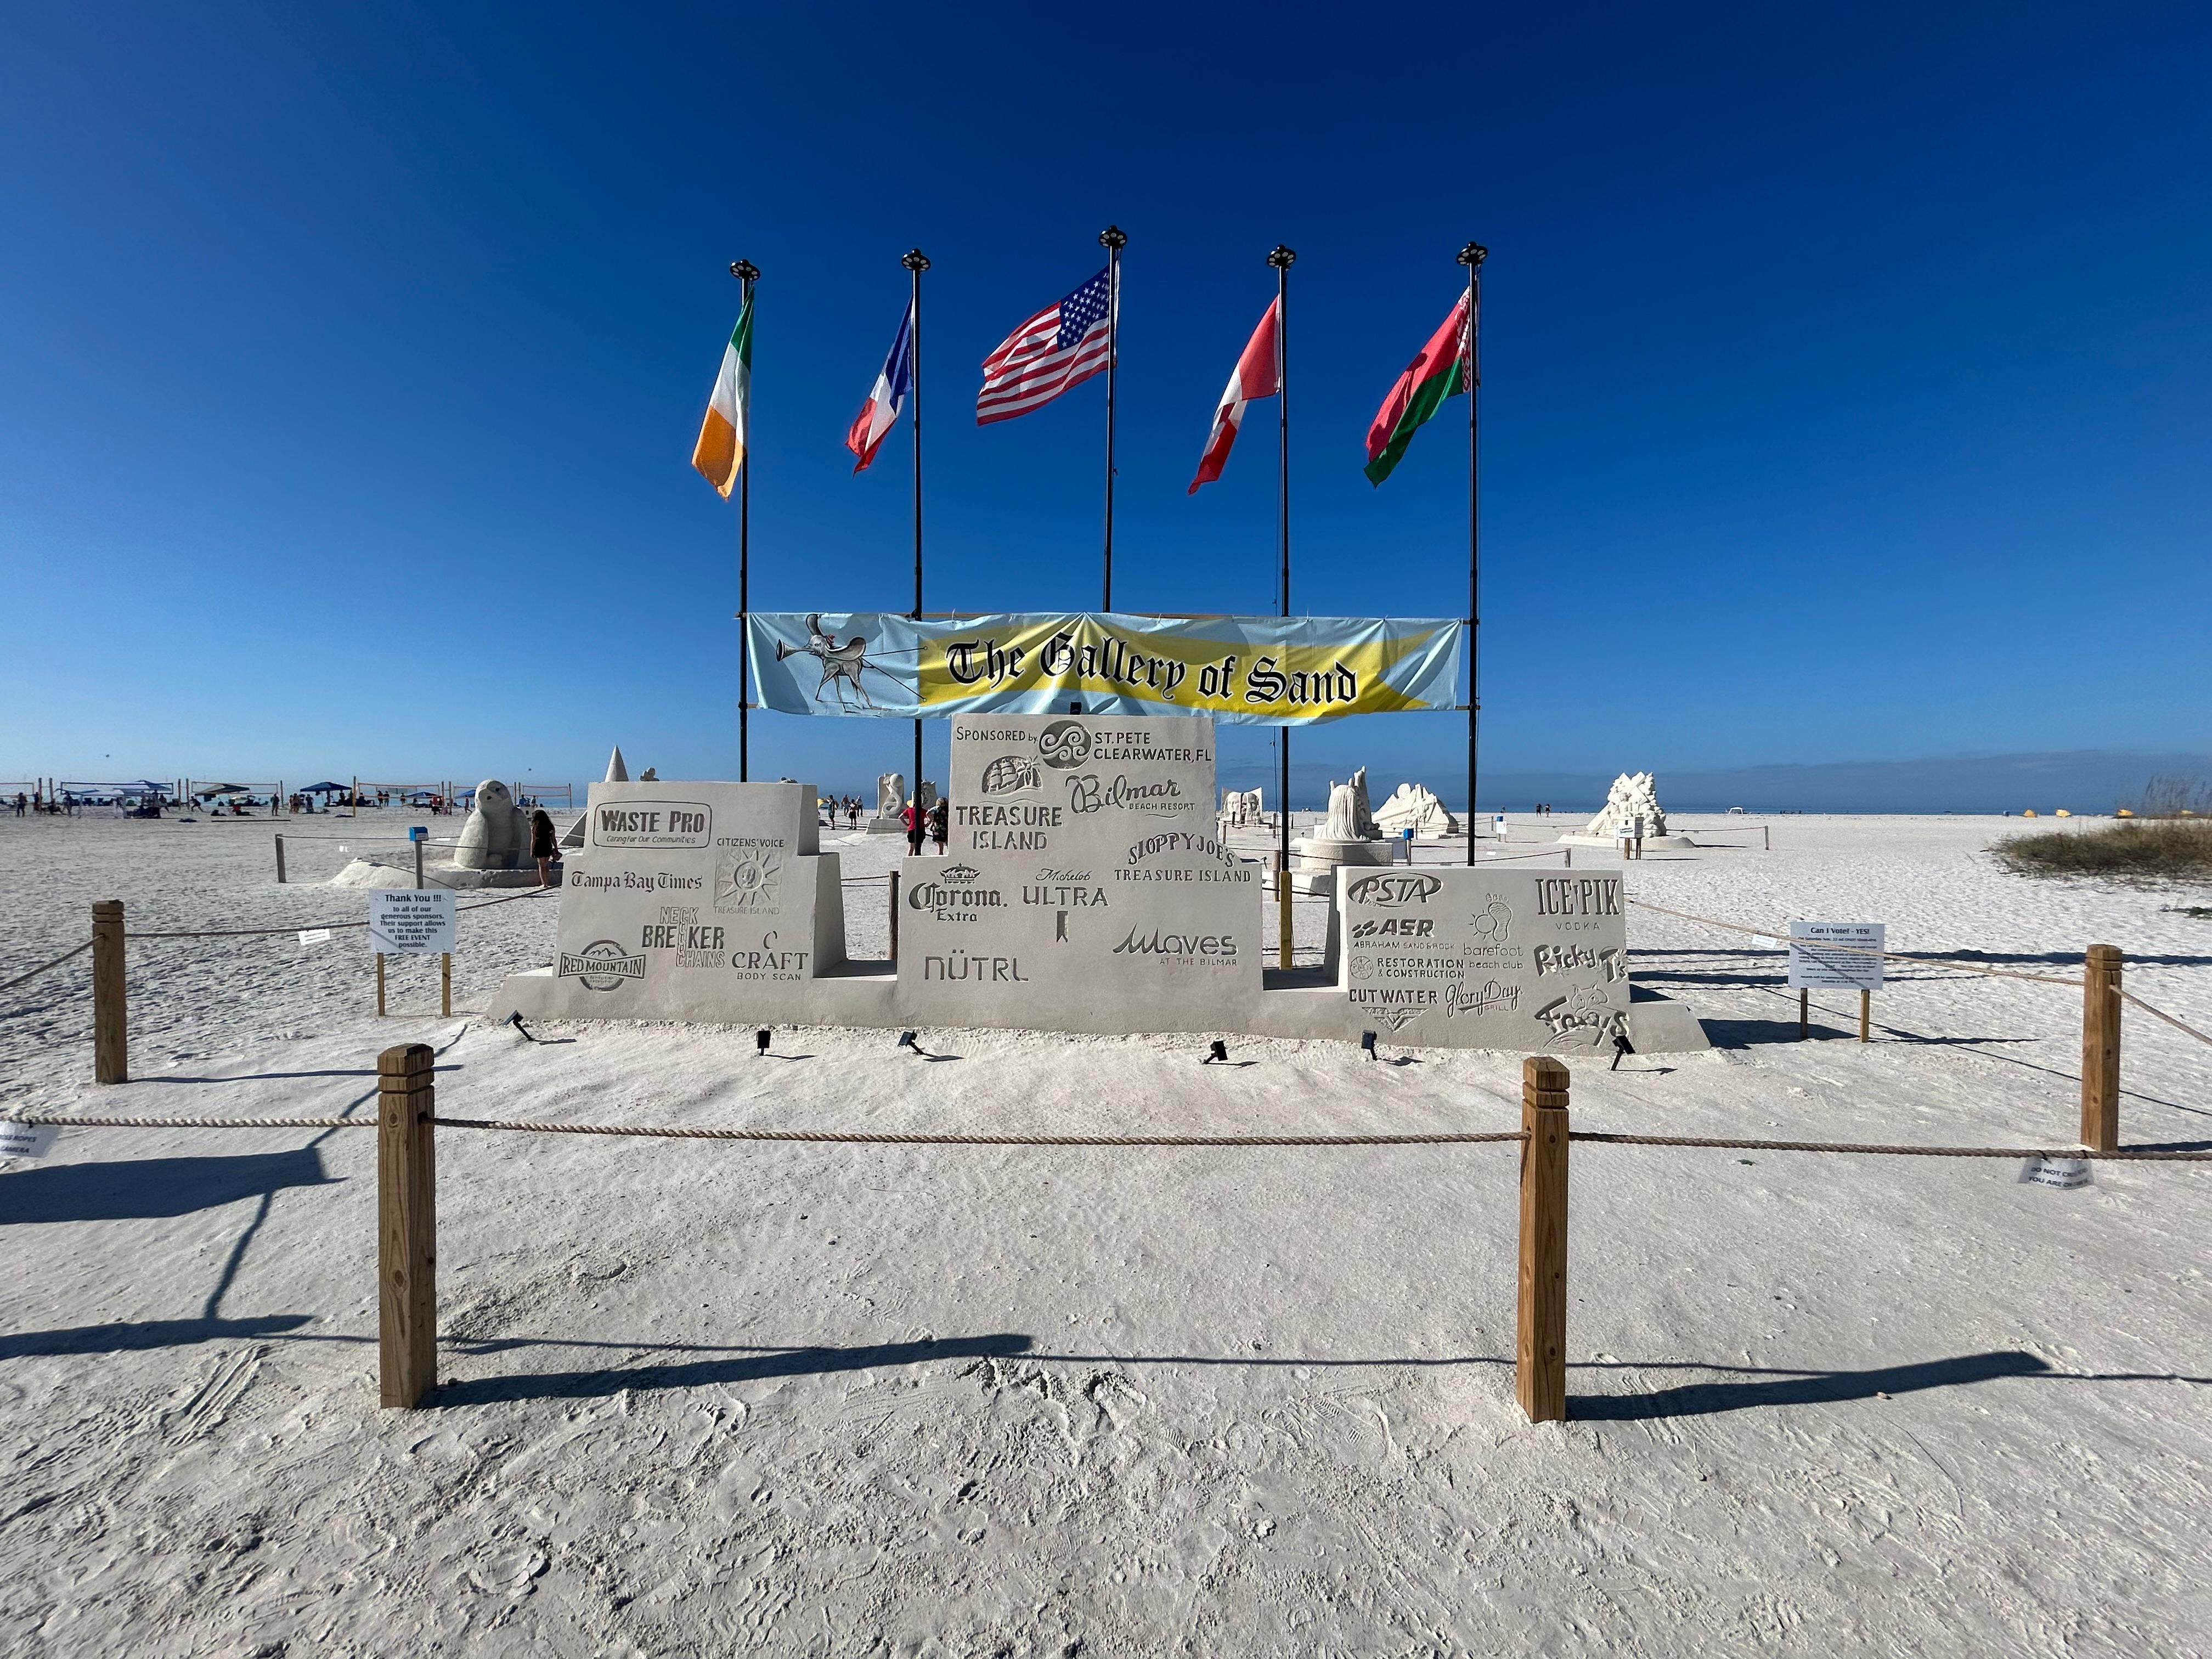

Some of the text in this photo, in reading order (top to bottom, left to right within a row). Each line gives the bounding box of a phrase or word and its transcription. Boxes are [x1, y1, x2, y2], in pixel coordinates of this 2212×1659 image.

[946, 631, 1357, 706] The Gallery of Sand
[956, 726, 1026, 741] SPONSORED
[1065, 773, 1181, 814] Bilmar
[1128, 802, 1196, 811] BEACH RESORT
[601, 809, 705, 833] WASTE PRO
[955, 805, 1063, 827] TREASURE
[652, 836, 696, 844] Communities
[759, 838, 785, 848] VOICE
[972, 831, 1048, 850] ISLAND
[1127, 832, 1235, 867] SLOPPY JOE'S
[571, 870, 703, 893] Tampa Bay Times
[1035, 868, 1093, 882] Michelob
[1114, 869, 1251, 883] TREASURE ISLAND
[385, 894, 411, 902] Thank
[1022, 885, 1109, 907] ULTRA
[1356, 877, 1430, 905] PSTA
[1535, 878, 1575, 916] ICE
[659, 906, 699, 924] NECK
[713, 906, 780, 915] TREASURE ISLAND
[936, 908, 978, 922] Extra
[1378, 918, 1435, 938] ASR
[1555, 922, 1601, 931] VODKA
[1352, 940, 1400, 949] ABRAHAM
[1463, 942, 1524, 957] barefoot
[562, 955, 643, 975] RED MOUNTAIN
[675, 950, 725, 969] CHAINS
[731, 951, 809, 970] CRAFT
[1159, 958, 1237, 967] AT THE BILMAR
[1377, 957, 1465, 969] RESTORATION
[1469, 961, 1524, 969] beach club
[737, 972, 802, 981] BODY SCAN
[1378, 968, 1465, 979] & CONSTRUCTION
